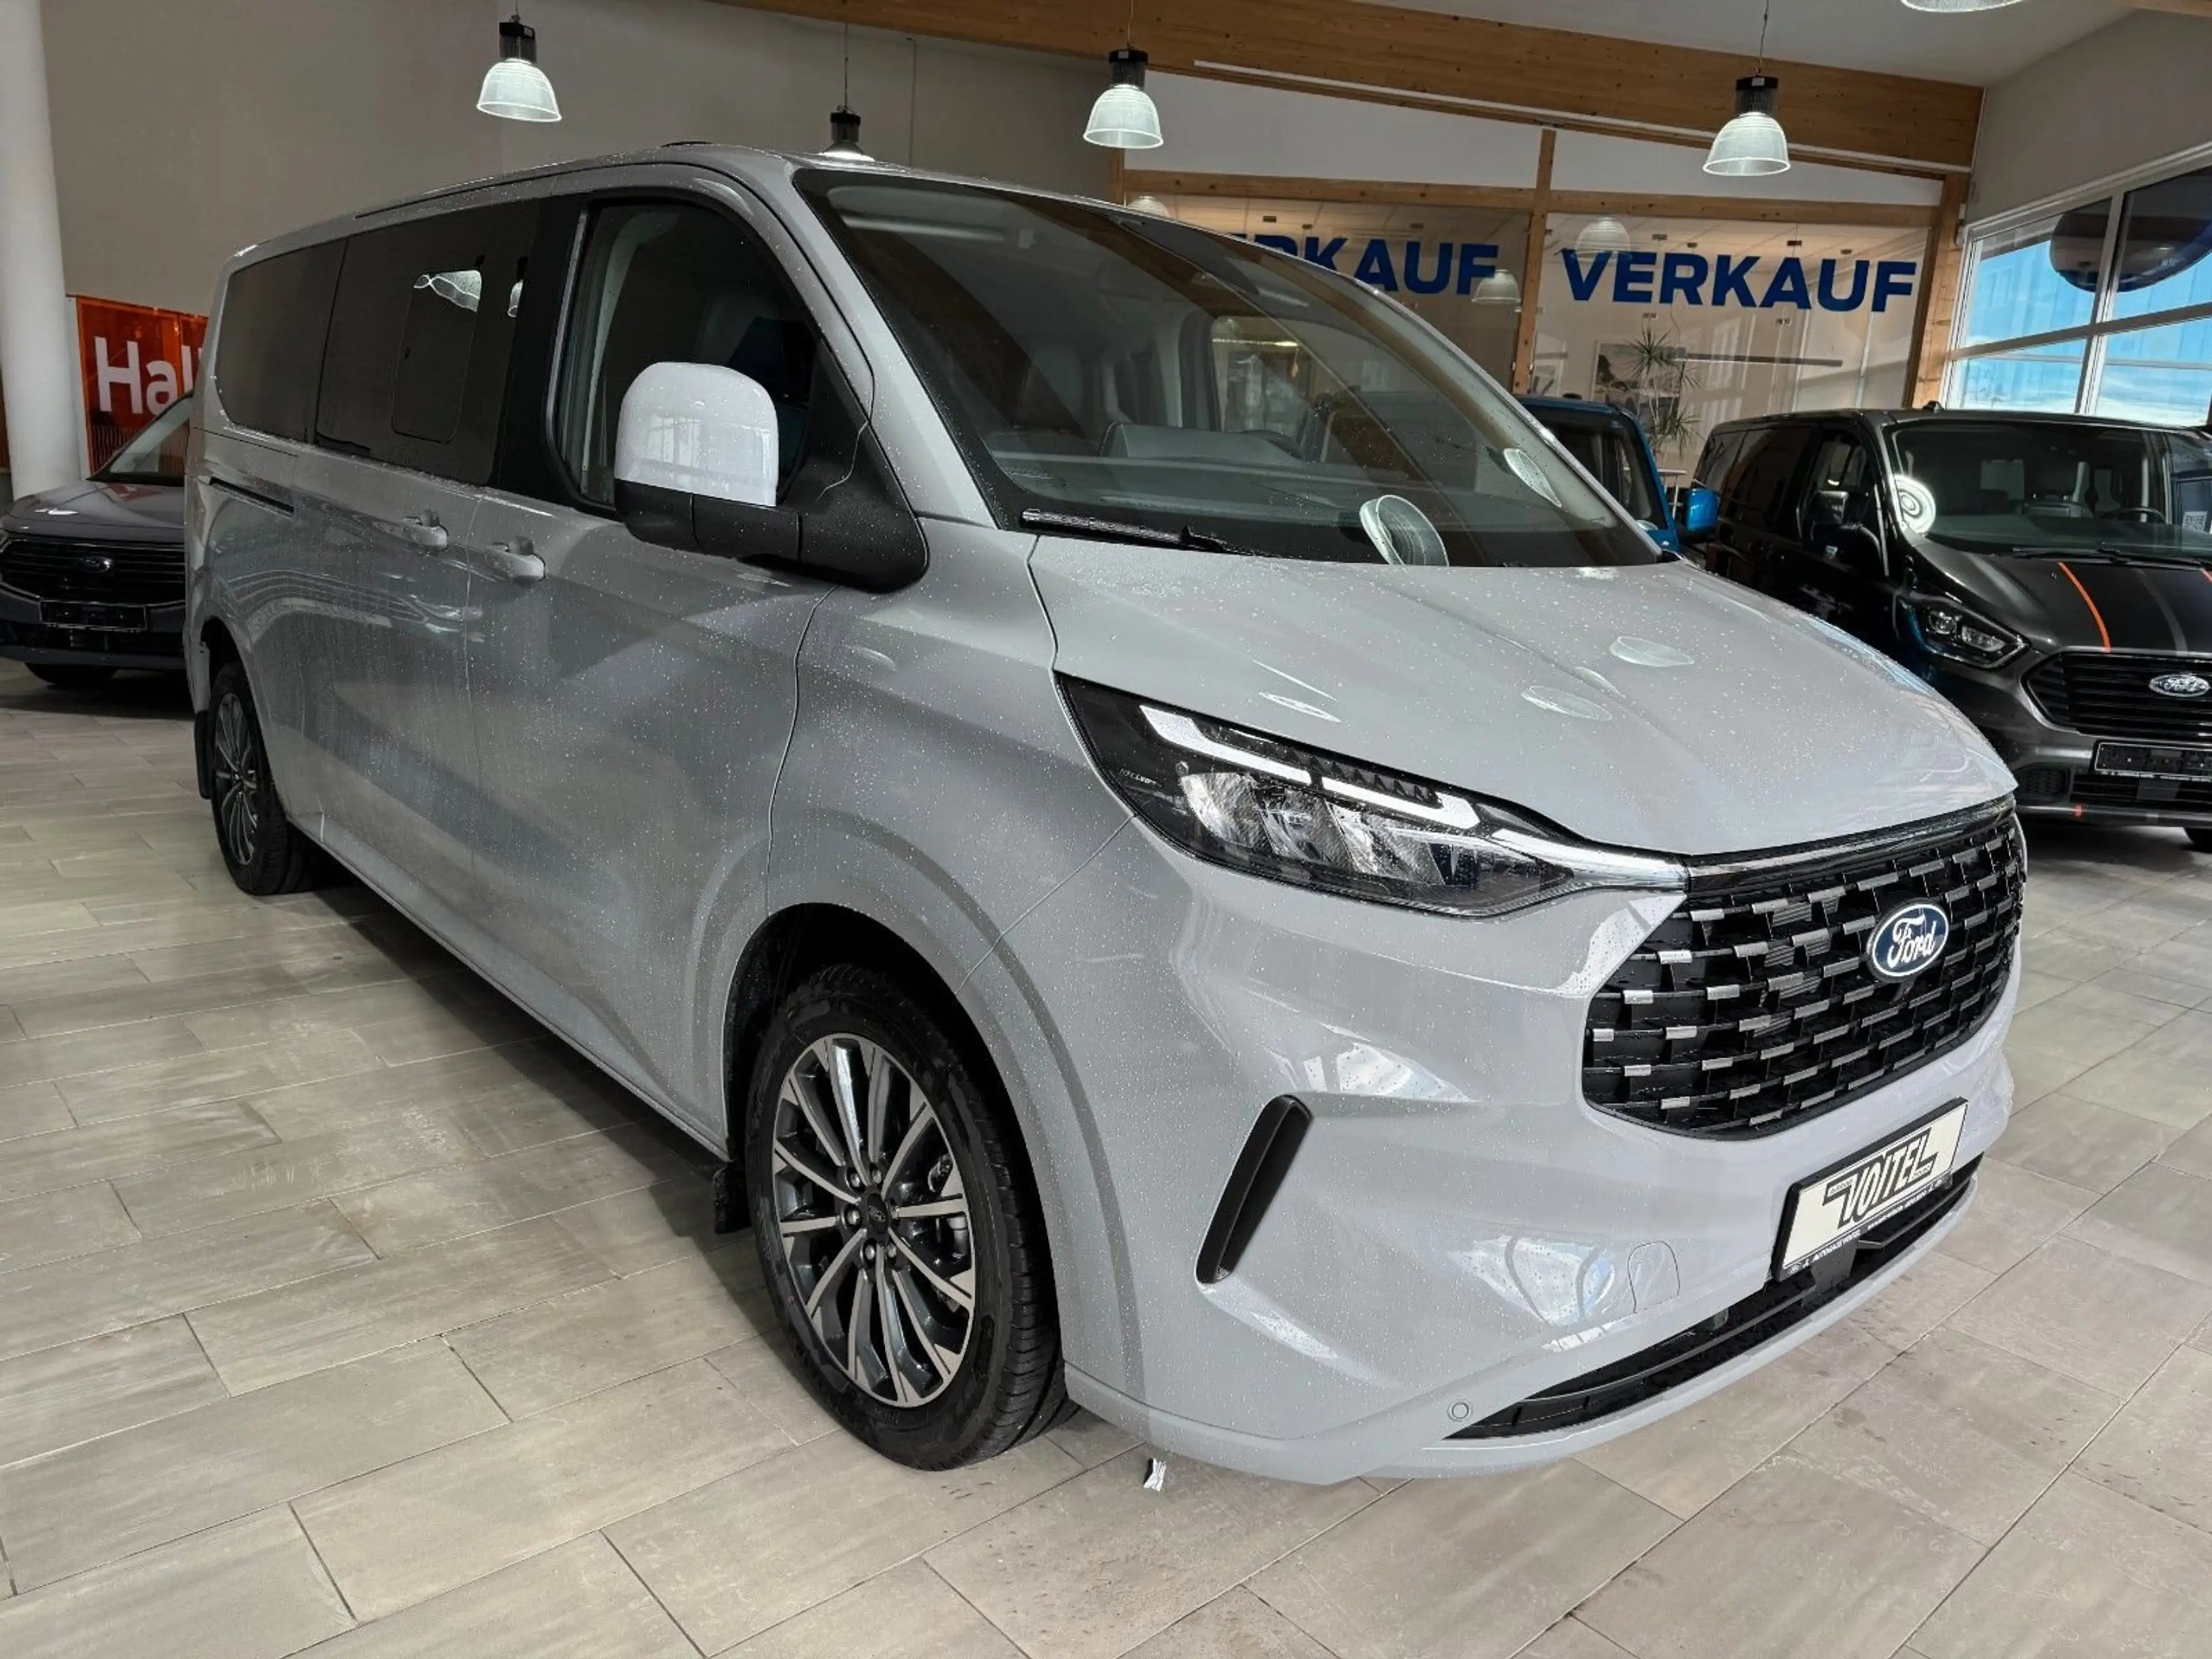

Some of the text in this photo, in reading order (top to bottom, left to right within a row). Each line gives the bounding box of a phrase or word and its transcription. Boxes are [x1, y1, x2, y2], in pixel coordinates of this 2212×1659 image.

[1561, 247, 1918, 312] VERKAUF
[94, 336, 202, 416] Hal
[1887, 914, 1937, 969] Ford
